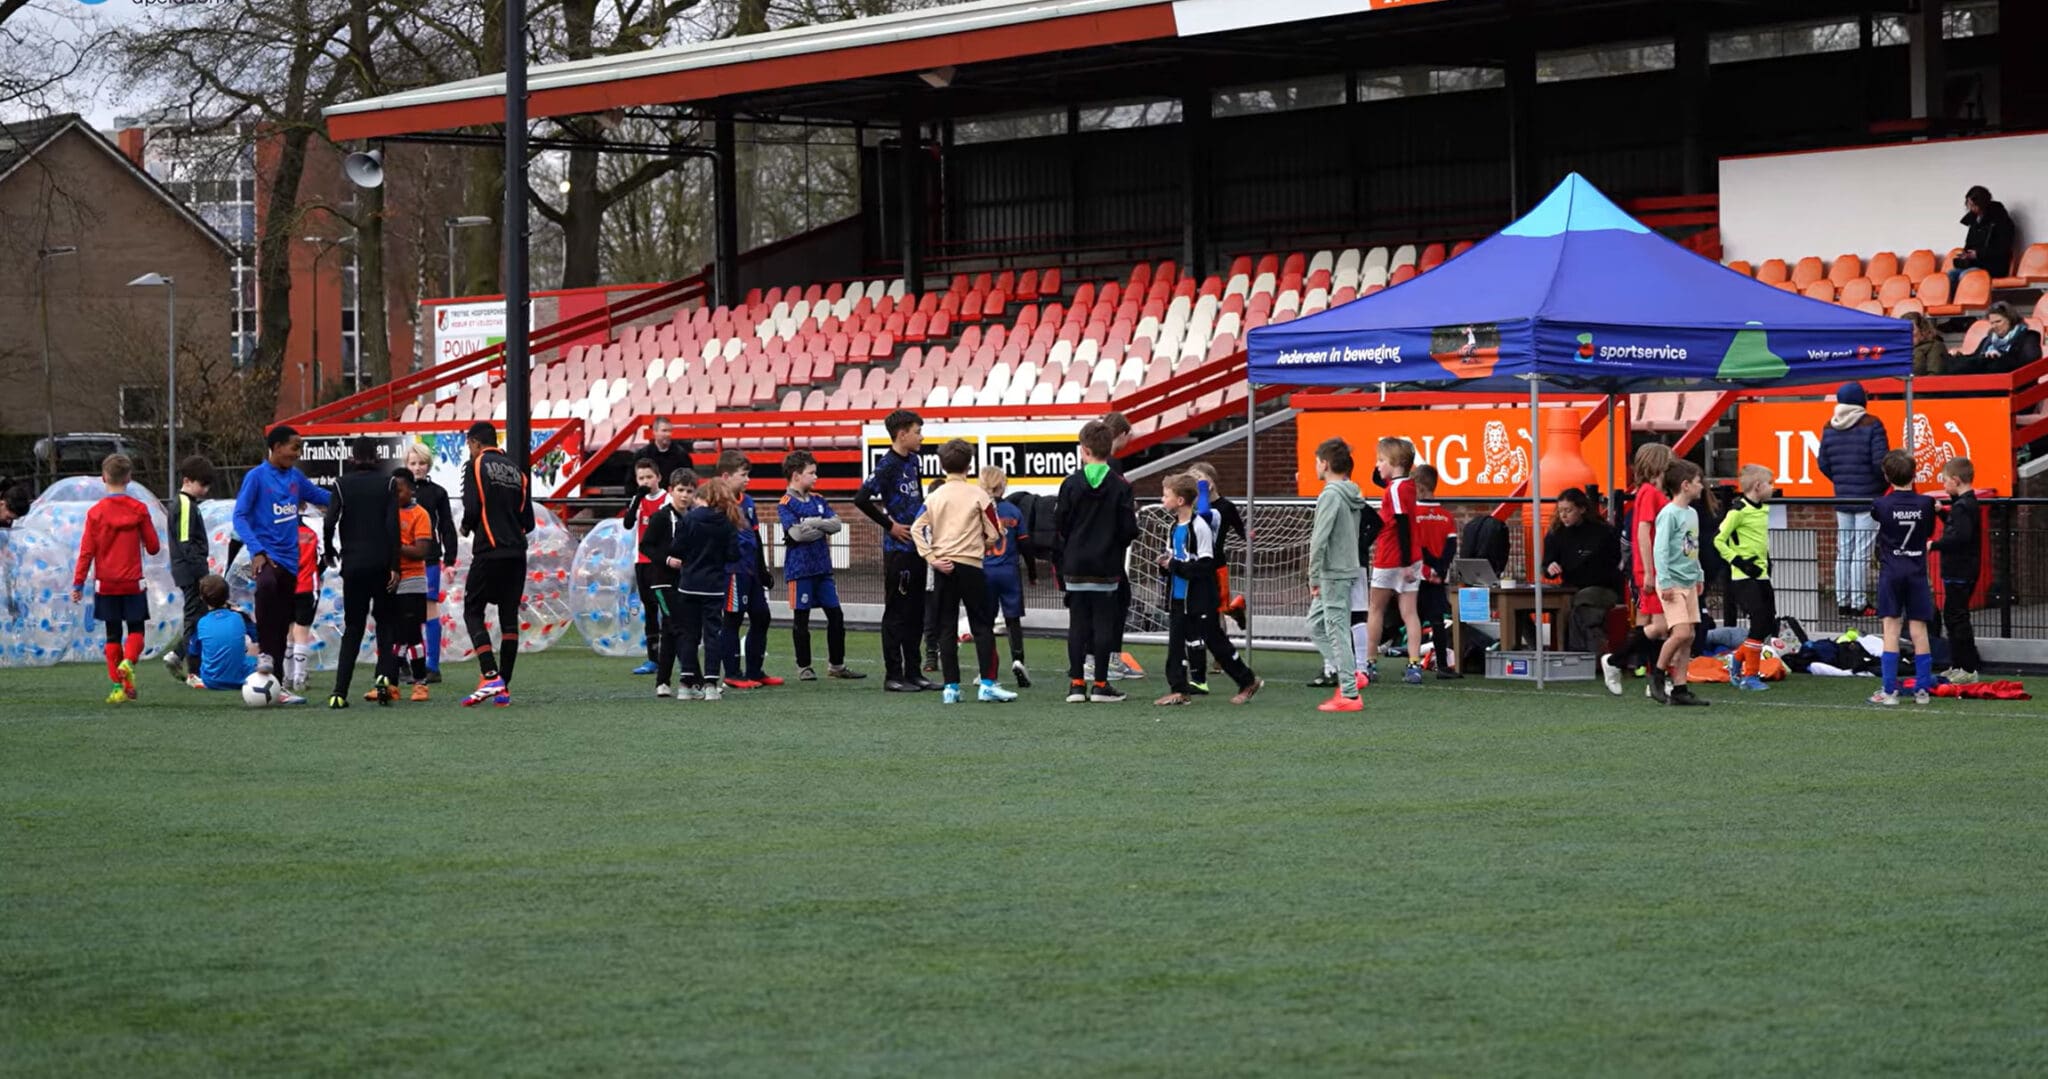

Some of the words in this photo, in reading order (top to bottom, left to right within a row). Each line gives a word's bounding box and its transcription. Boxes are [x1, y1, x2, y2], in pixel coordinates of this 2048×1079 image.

[1329, 347, 1341, 362] in
[1343, 343, 1402, 364] beweging
[1600, 344, 1687, 361] sportservice
[1378, 434, 1471, 486] NG
[1774, 430, 1821, 484] IN
[1893, 510, 1922, 520] MBAPPÉ
[1898, 521, 1916, 550] 7
